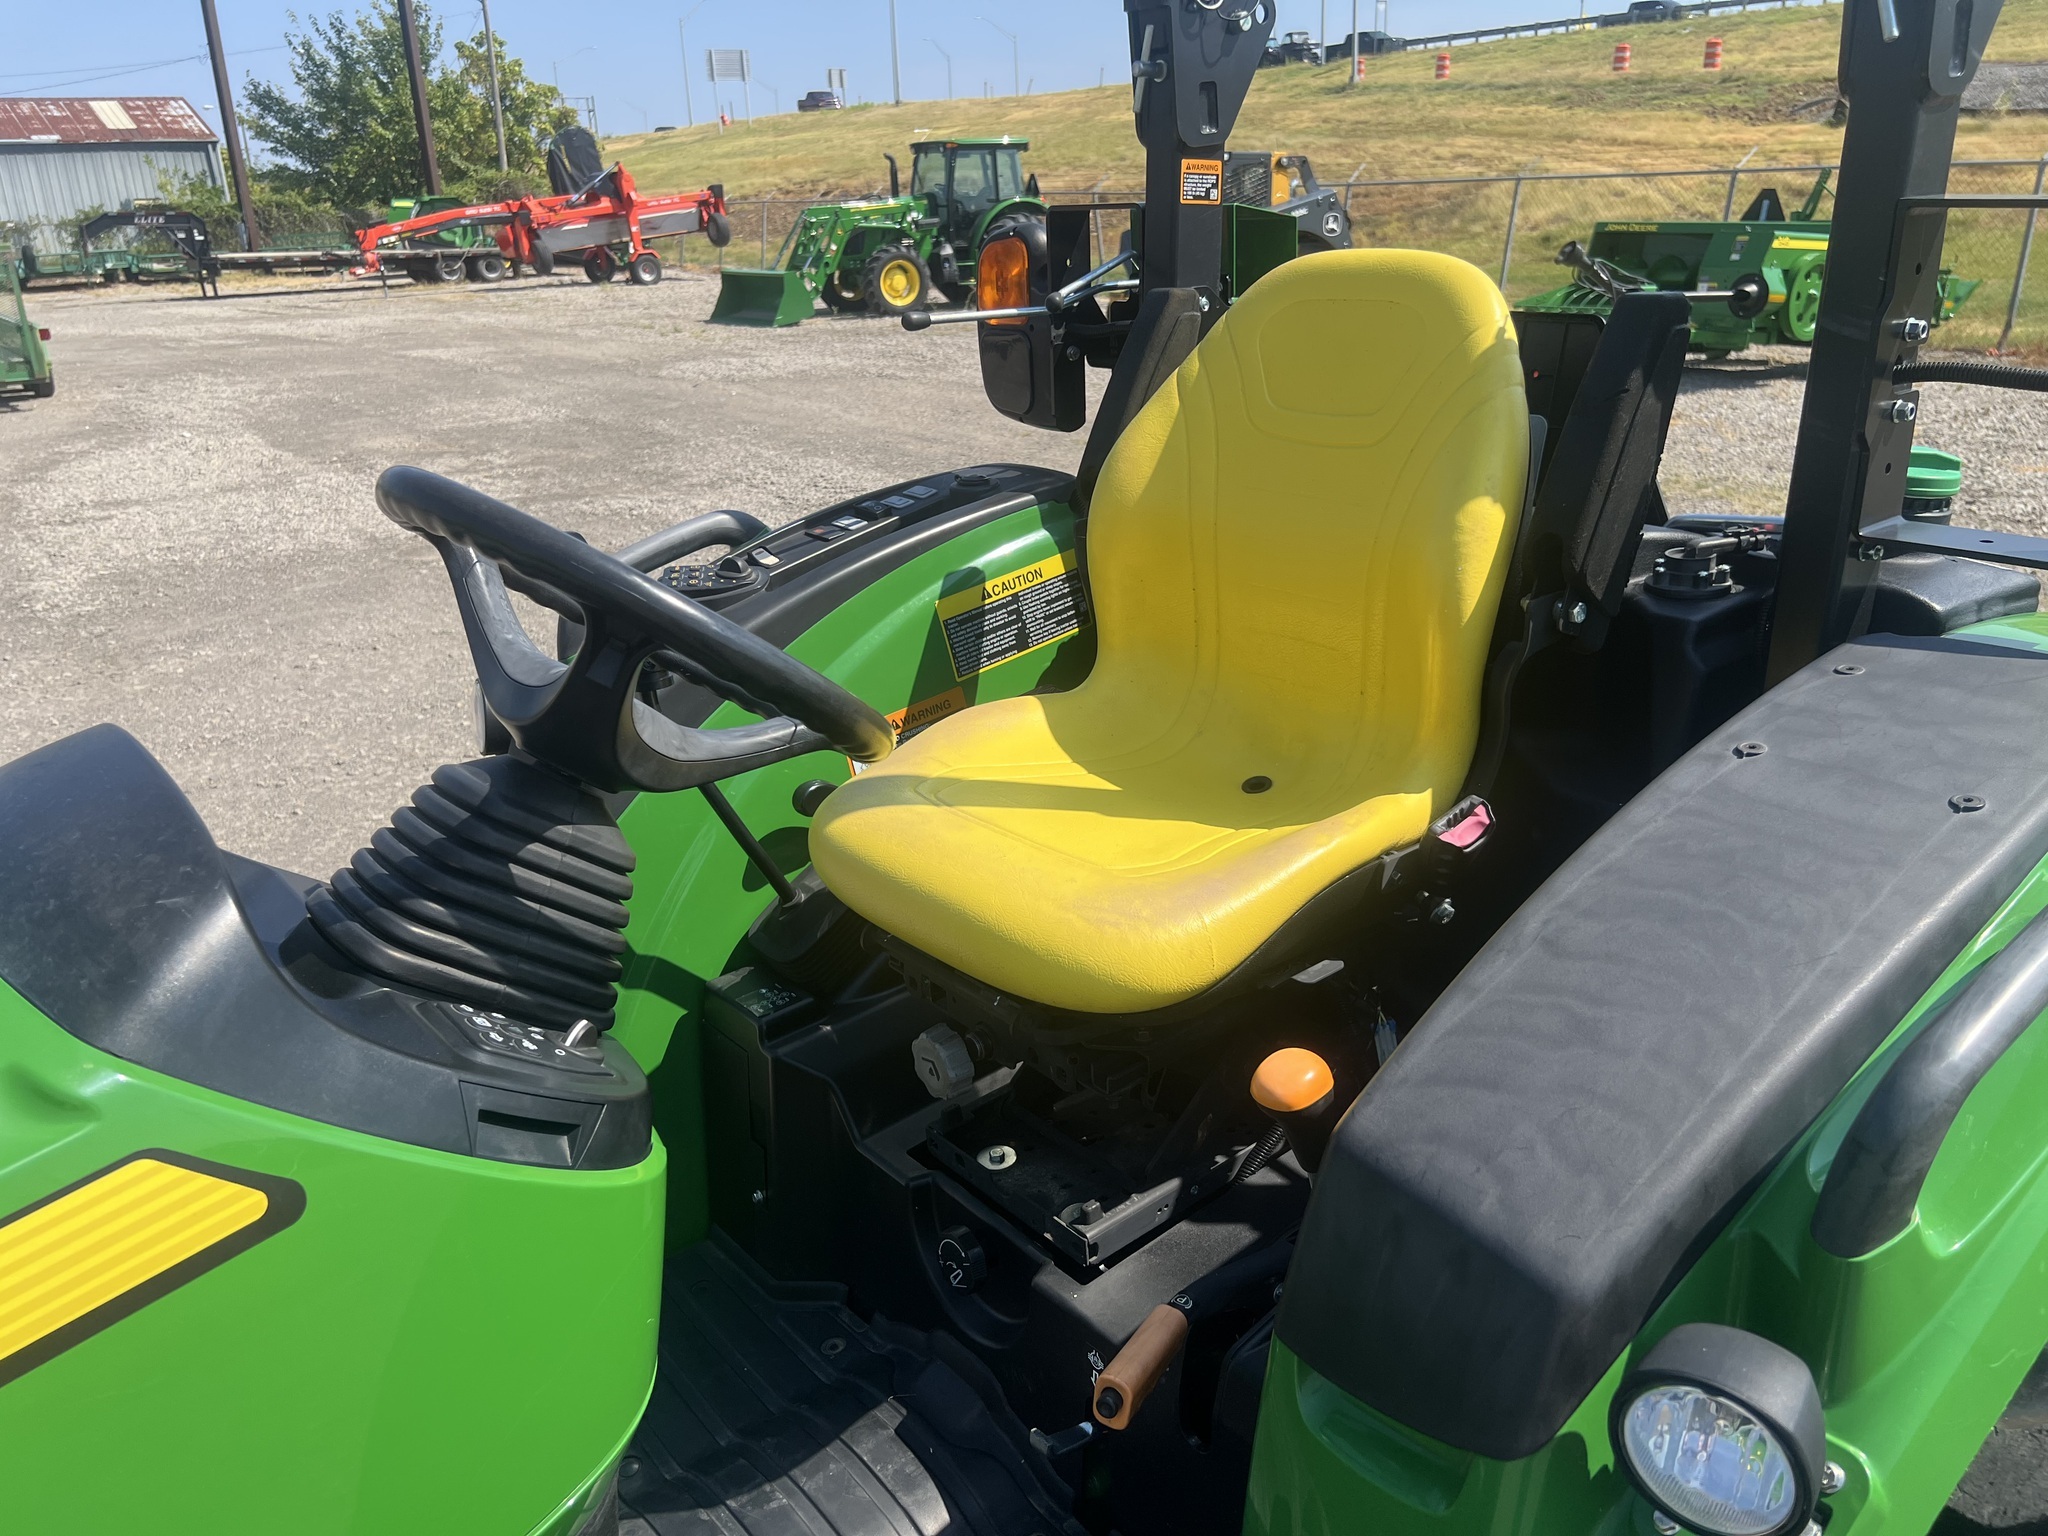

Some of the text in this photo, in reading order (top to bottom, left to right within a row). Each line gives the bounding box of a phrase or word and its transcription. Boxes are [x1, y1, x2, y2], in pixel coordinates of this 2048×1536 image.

[1191, 164, 1218, 172] WARNING
[134, 216, 166, 224] ELITE
[992, 568, 1044, 596] CAUTION
[900, 699, 952, 728] WARNING
